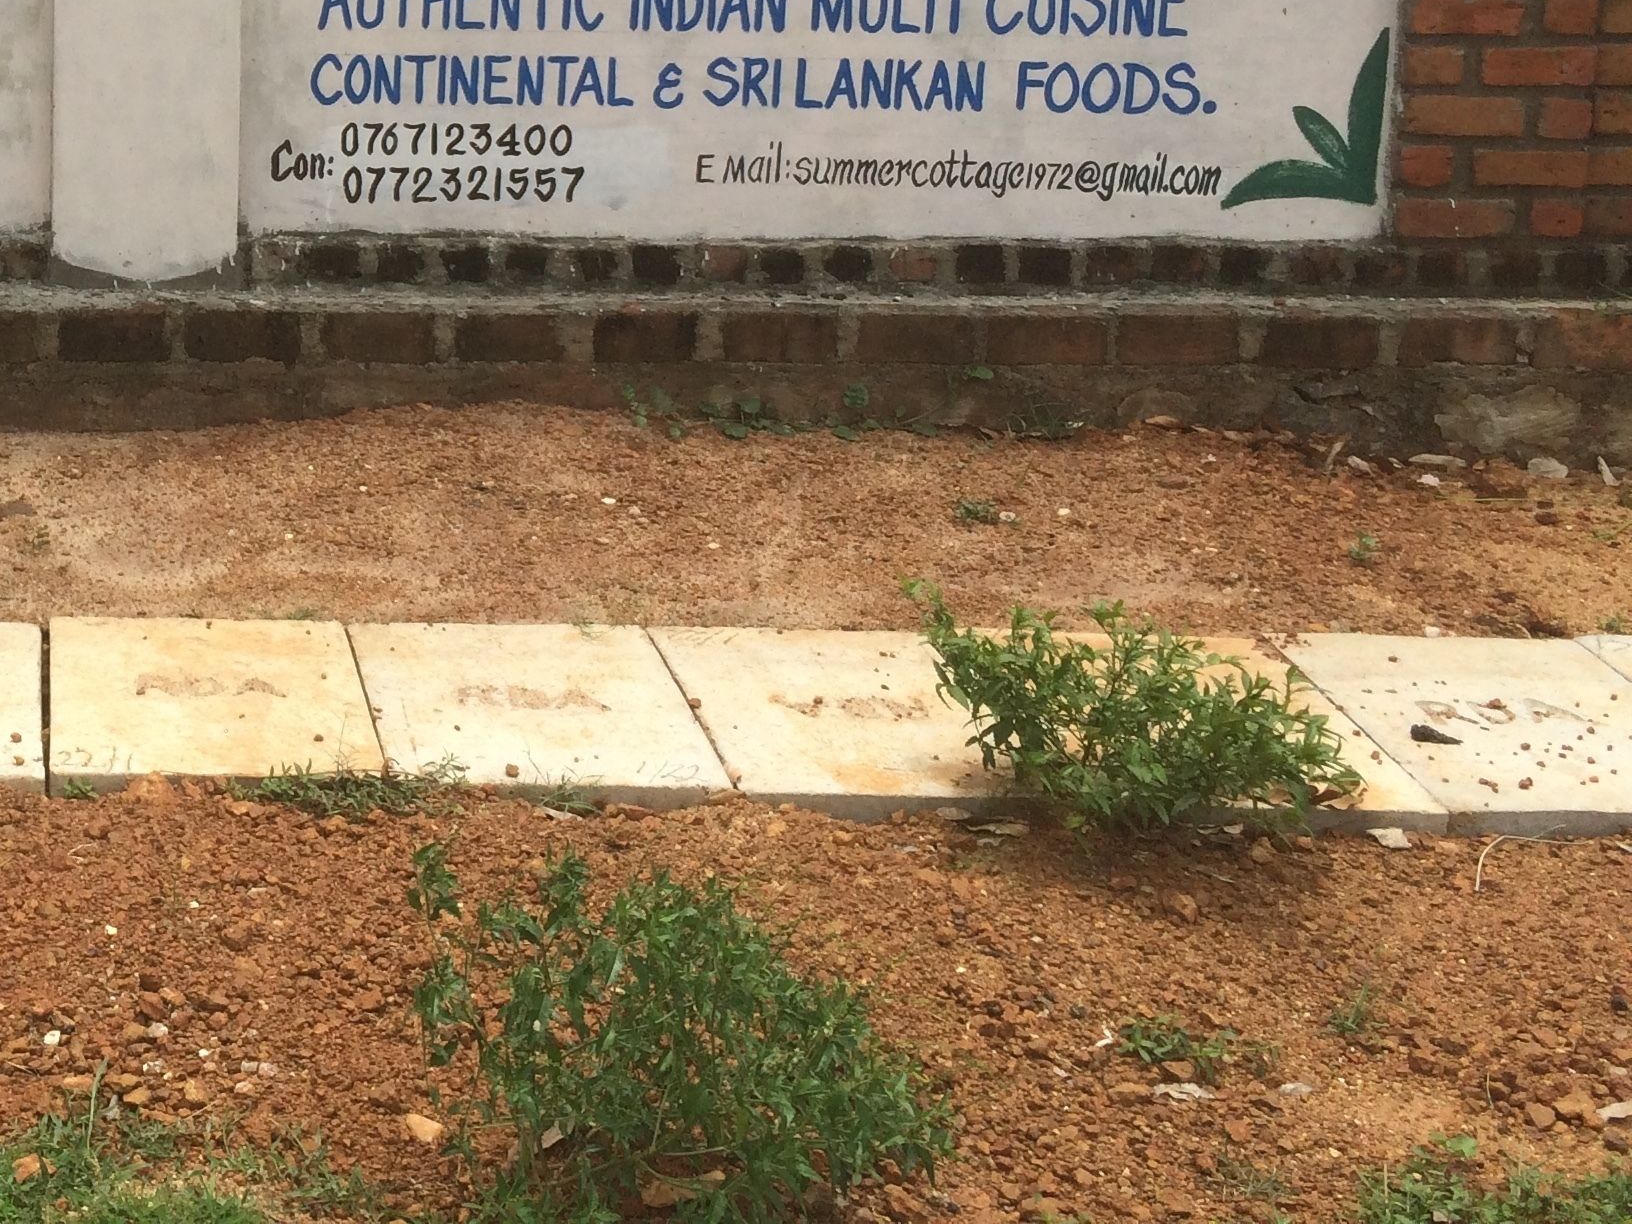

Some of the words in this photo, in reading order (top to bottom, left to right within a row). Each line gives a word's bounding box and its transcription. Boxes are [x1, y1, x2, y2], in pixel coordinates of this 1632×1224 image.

[311, 54, 633, 106] CONTINENTAL
[653, 63, 683, 109] &
[703, 57, 781, 108] SRI
[795, 58, 985, 112] LANKAN
[1016, 62, 1216, 115] FOODS.
[341, 123, 572, 156] 0767123400
[270, 139, 334, 182] Con:
[343, 166, 584, 204] 0772321557
